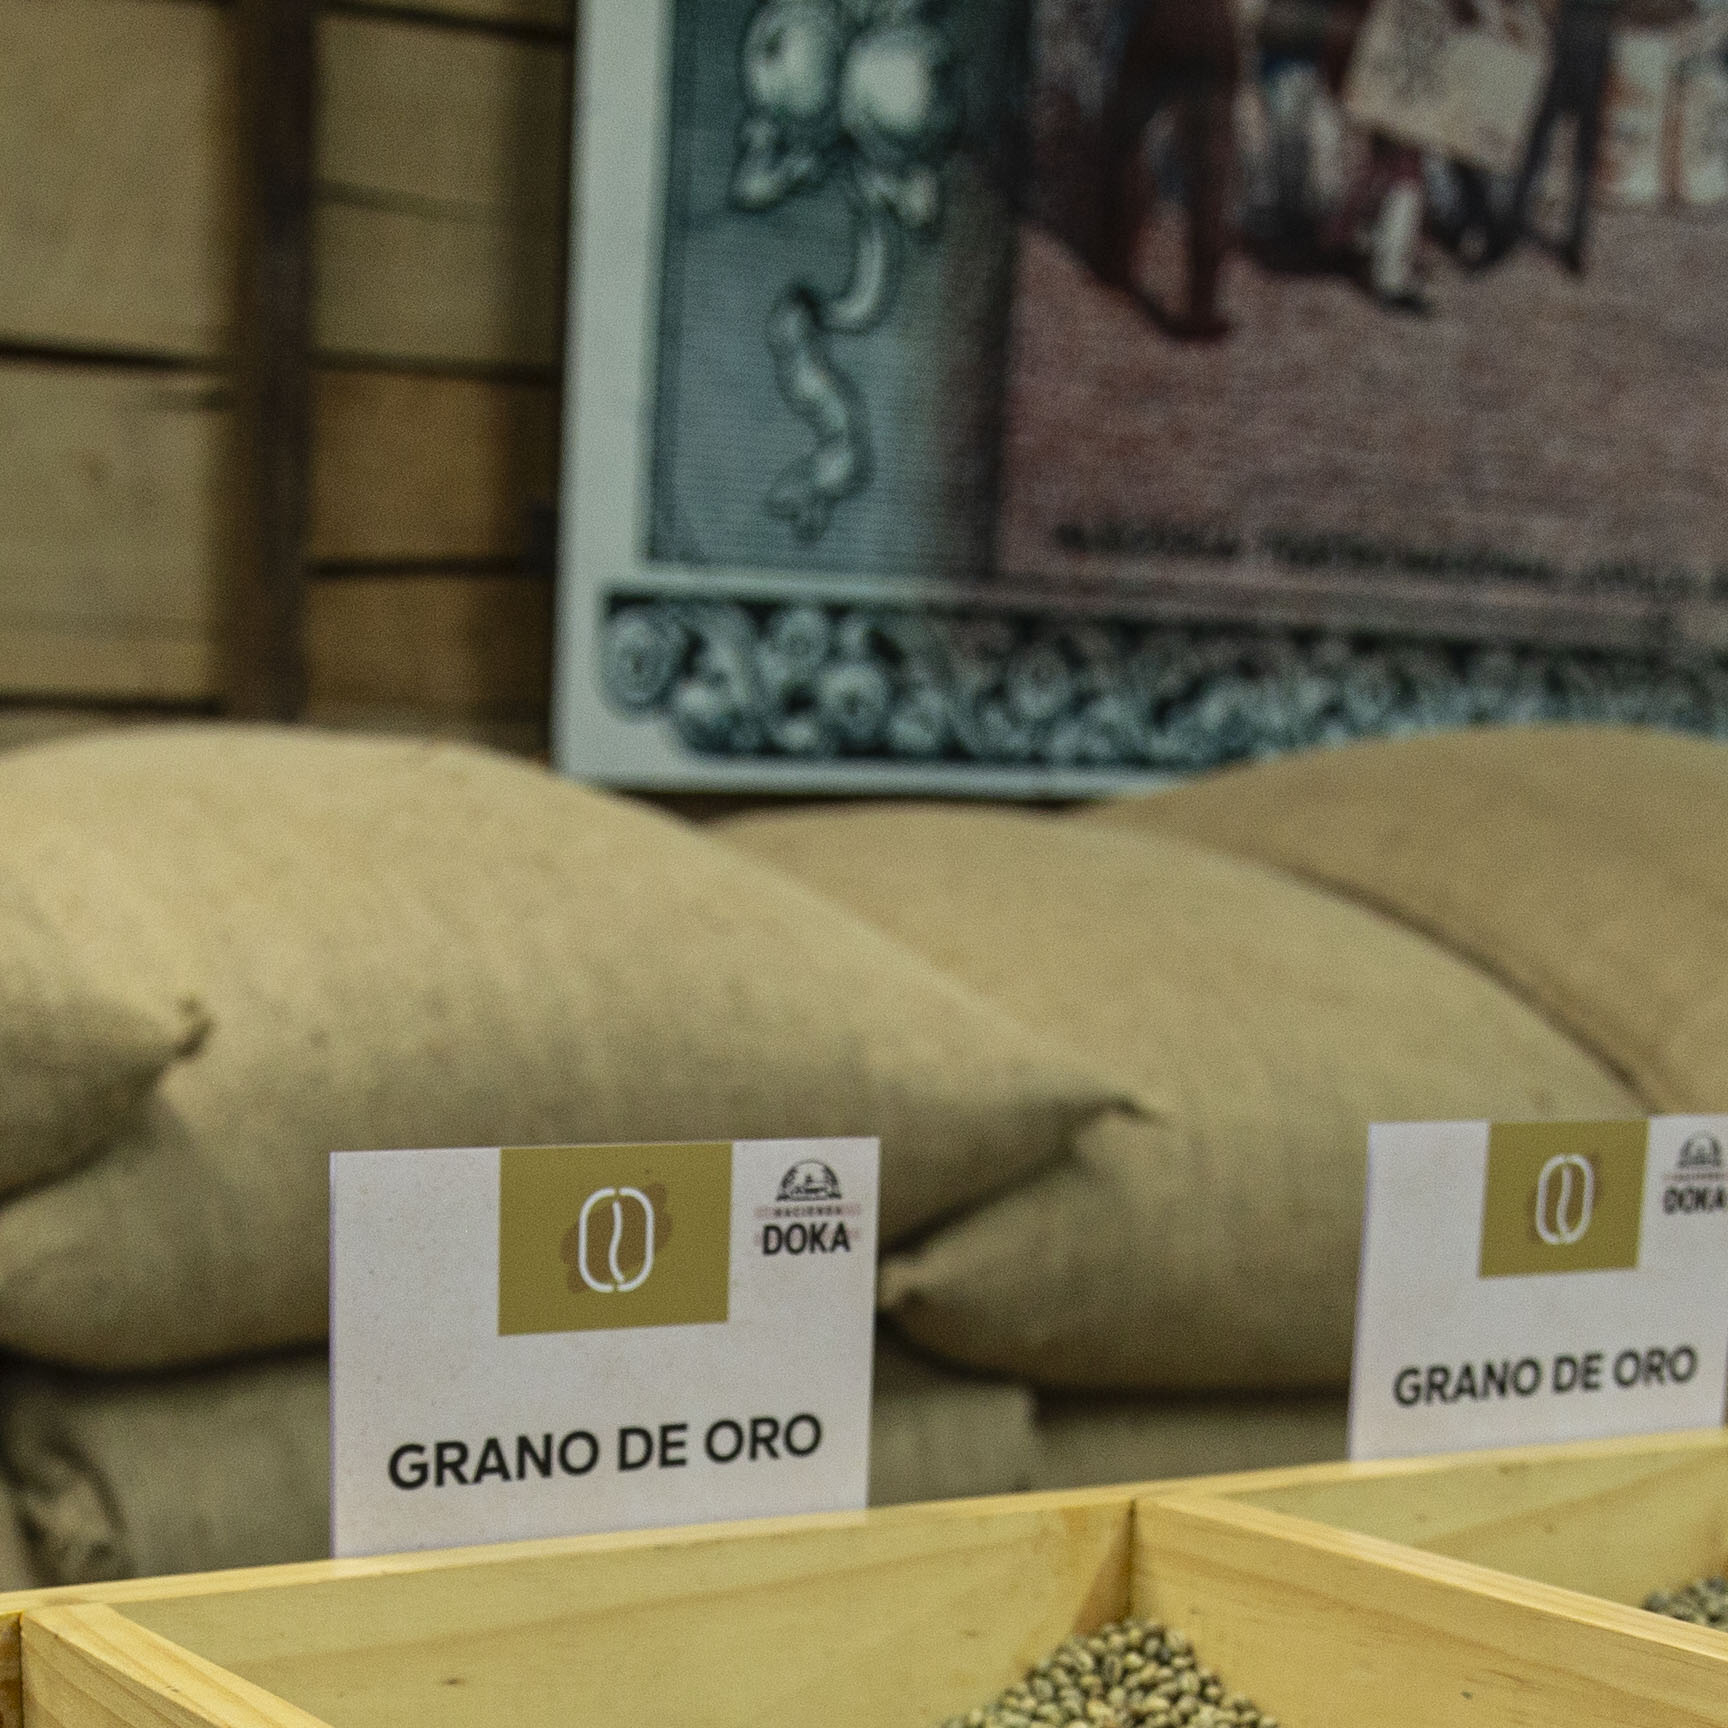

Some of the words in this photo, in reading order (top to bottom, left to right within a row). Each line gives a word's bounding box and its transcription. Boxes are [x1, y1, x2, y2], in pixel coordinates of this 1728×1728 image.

[763, 1222, 850, 1255] DOKA
[1394, 1358, 1542, 1407] GRANO
[1552, 1353, 1603, 1393] DE
[1613, 1346, 1698, 1389] ORO
[388, 1431, 600, 1491] GRANO
[618, 1424, 688, 1472] DE
[705, 1414, 823, 1463] ORO
